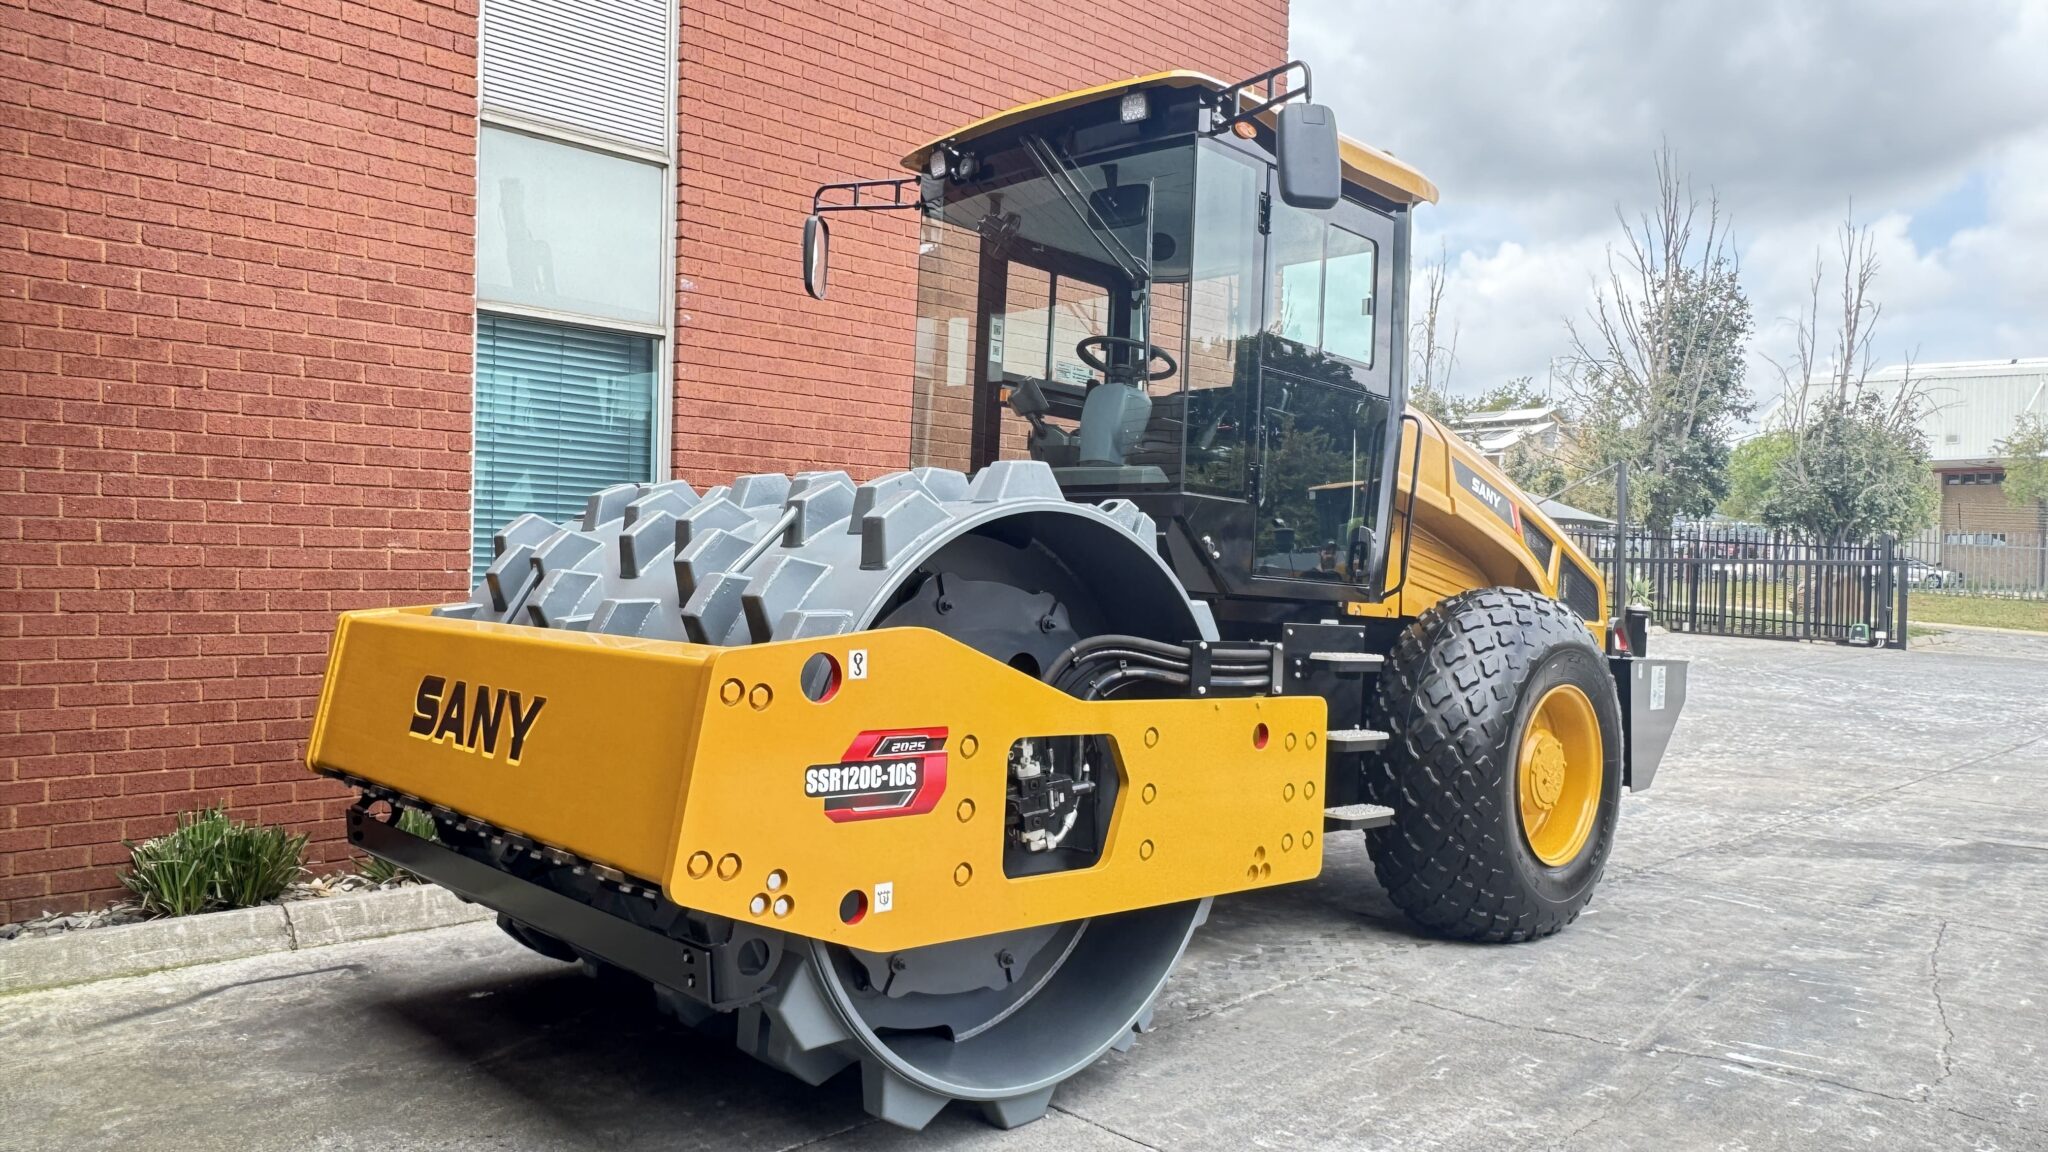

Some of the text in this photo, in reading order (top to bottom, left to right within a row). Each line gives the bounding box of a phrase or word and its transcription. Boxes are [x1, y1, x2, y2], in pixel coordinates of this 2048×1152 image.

[1471, 477, 1502, 508] SANY
[409, 675, 548, 766] SANY
[891, 741, 926, 752] 2025
[806, 762, 917, 793] SSR120C-10S
